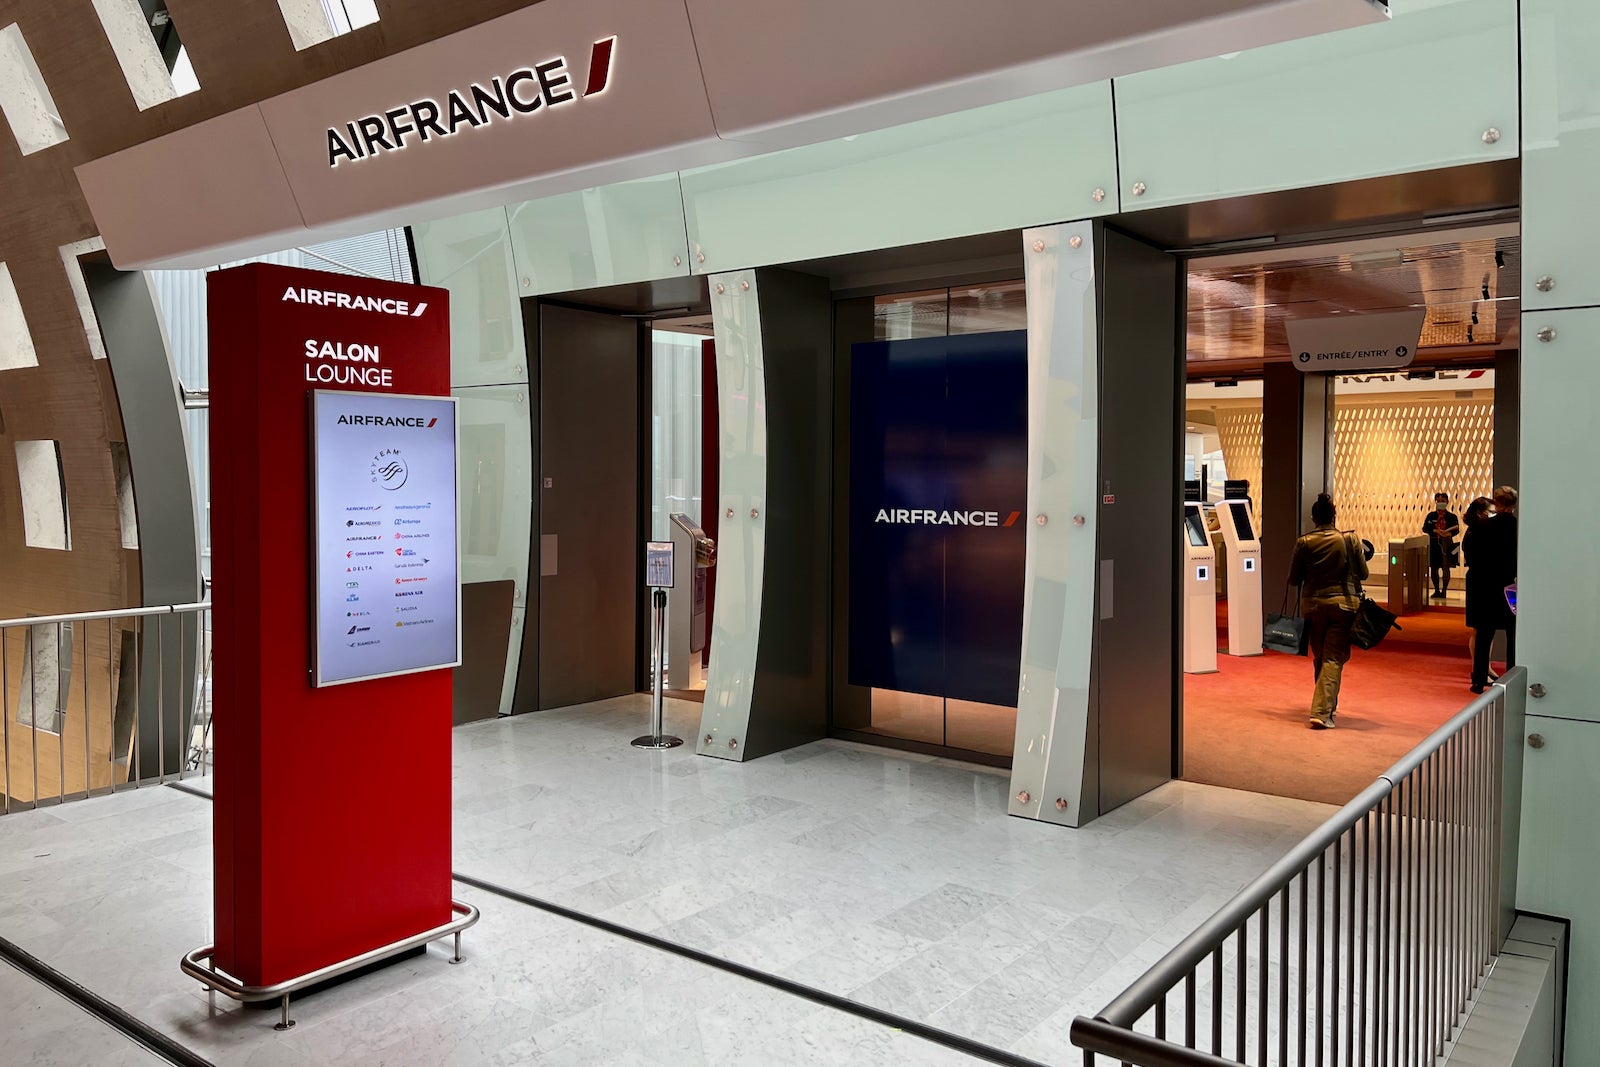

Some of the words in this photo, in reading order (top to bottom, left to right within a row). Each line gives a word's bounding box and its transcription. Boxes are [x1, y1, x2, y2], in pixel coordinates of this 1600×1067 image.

[326, 55, 575, 168] AIRFRANCE
[282, 286, 409, 316] AIRFRANCE
[305, 339, 380, 363] SALON
[1317, 349, 1390, 361] ENTRÉE/ENTRY
[305, 363, 393, 387] LOUNGE
[337, 414, 425, 428] AIRFRANCE
[370, 448, 400, 483] SKYTEAM
[874, 508, 999, 527] AIRFRANCE
